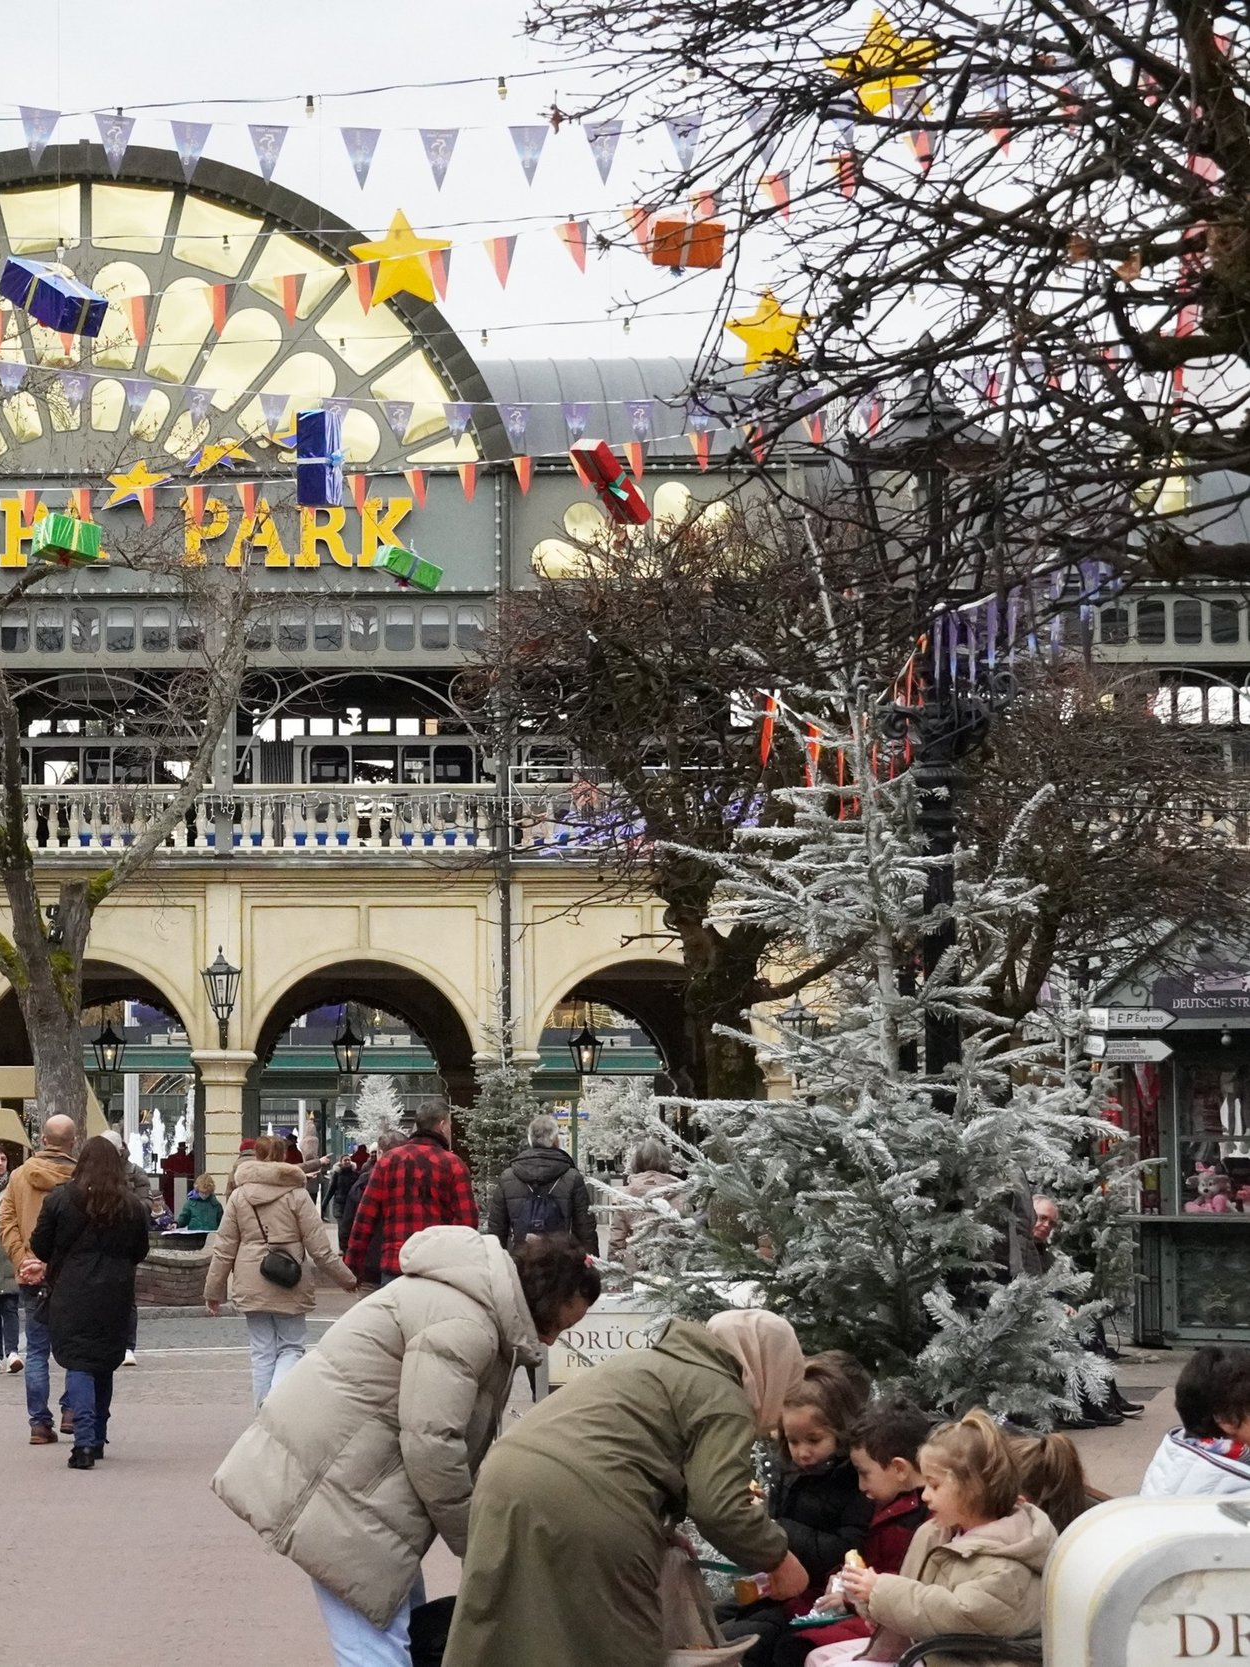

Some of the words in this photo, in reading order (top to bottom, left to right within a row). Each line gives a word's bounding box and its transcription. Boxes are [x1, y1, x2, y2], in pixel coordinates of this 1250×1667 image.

[180, 497, 412, 568] PARK
[1135, 1013, 1164, 1026] Express
[566, 1354, 617, 1368] PRES
